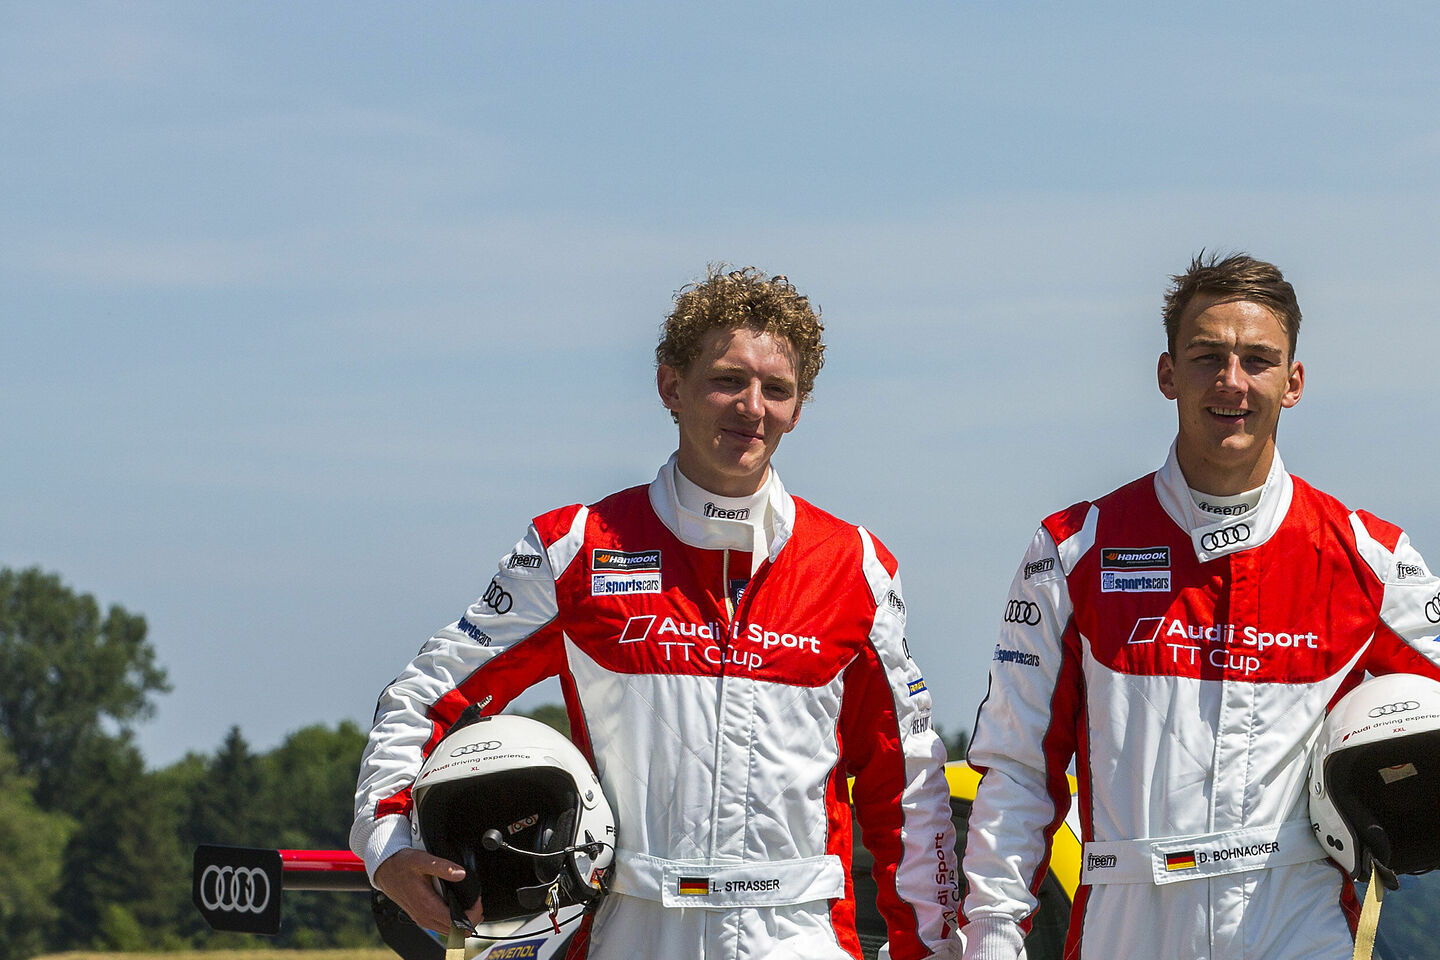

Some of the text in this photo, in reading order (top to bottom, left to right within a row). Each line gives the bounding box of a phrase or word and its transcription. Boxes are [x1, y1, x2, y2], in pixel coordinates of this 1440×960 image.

[704, 502, 749, 520] freem
[748, 623, 821, 654] Sport
[1166, 619, 1318, 651] Audi Sport
[659, 642, 763, 671] TT Cup
[1167, 643, 1260, 675] TT Cup
[1351, 725, 1371, 736] Audi
[1373, 718, 1403, 728] driving
[451, 756, 481, 767] driving
[483, 753, 531, 763] experience
[935, 832, 949, 885] Sport
[1200, 842, 1280, 864] D. BOHNACKER
[712, 879, 780, 893] L. STRASSER
